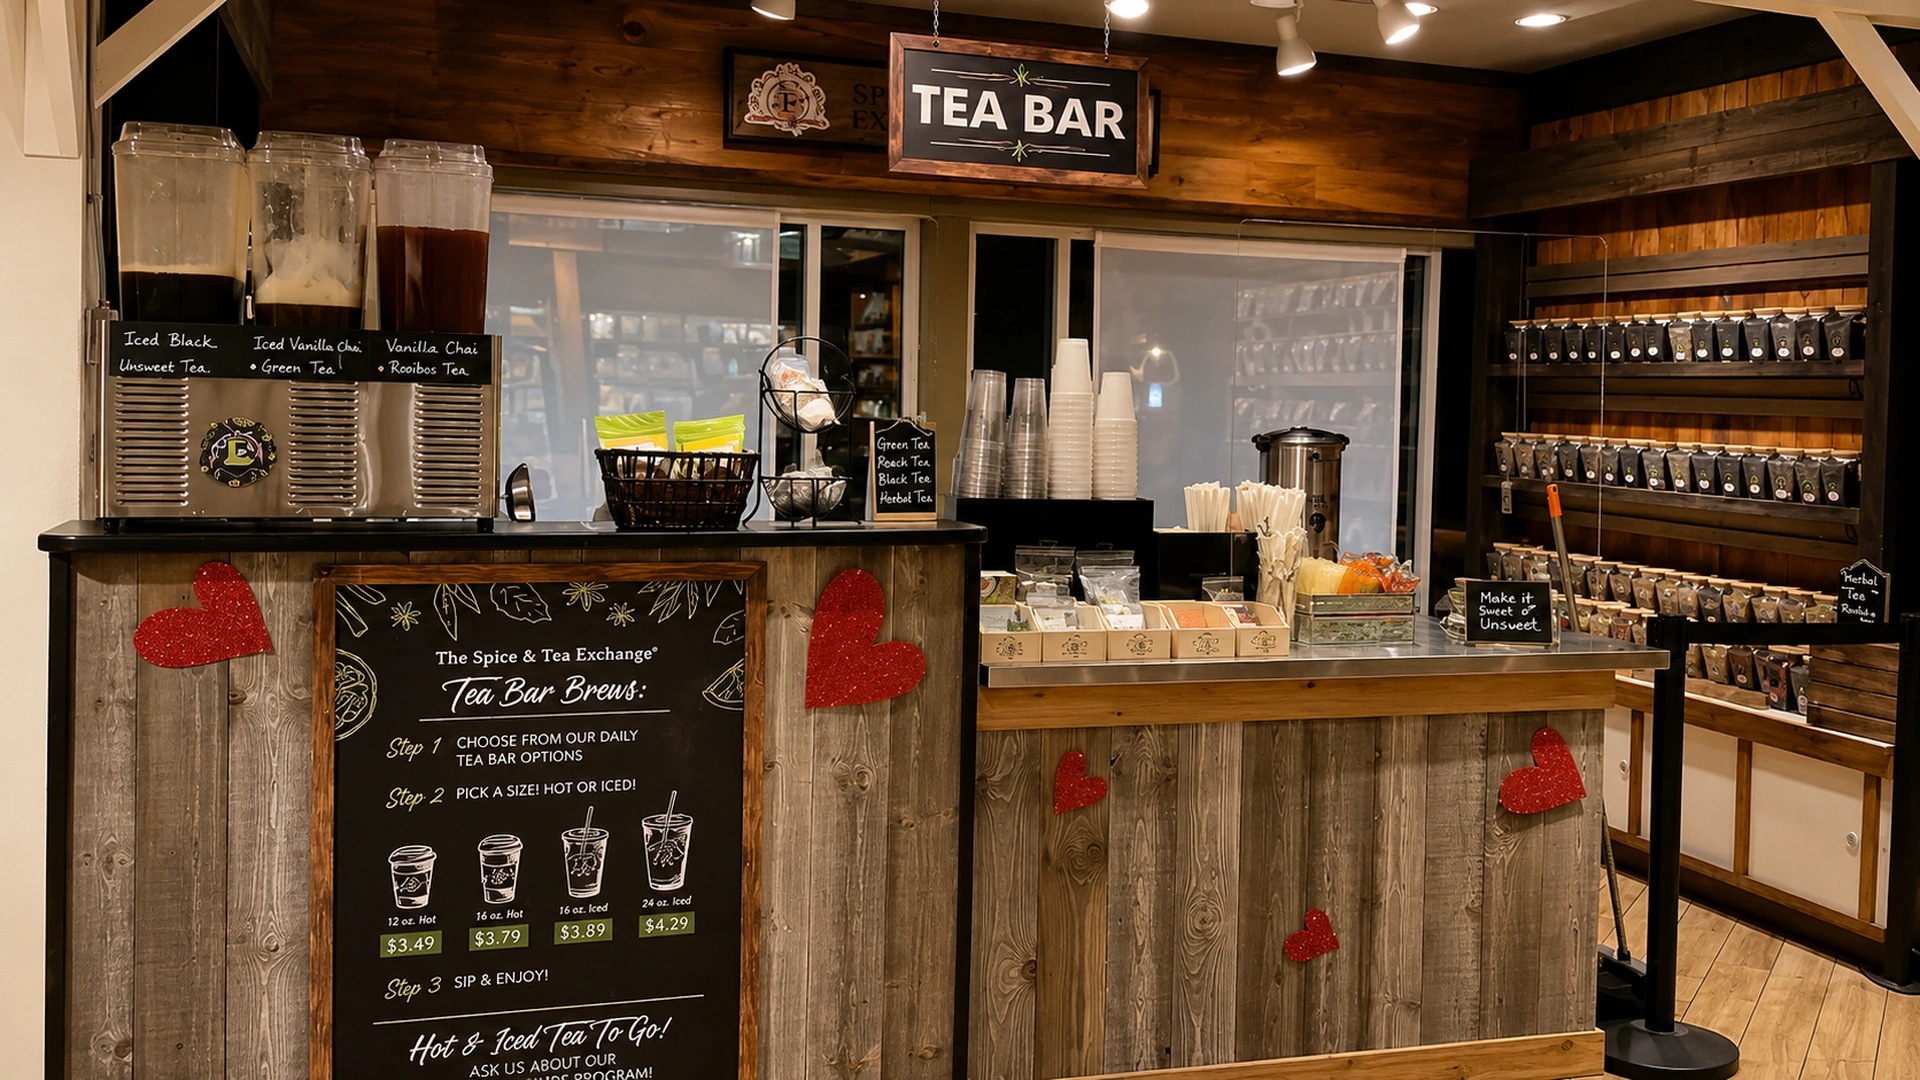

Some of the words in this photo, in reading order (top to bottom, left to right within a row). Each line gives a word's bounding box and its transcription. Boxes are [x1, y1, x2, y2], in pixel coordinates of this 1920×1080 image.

[912, 83, 1008, 131] TEA
[1024, 94, 1126, 140] BAR
[123, 331, 160, 347] Iced
[168, 332, 218, 349] Black
[253, 335, 284, 350] Iced
[289, 336, 334, 351] Vanilla
[385, 338, 439, 354] Vanilla
[445, 341, 478, 355] Chai
[119, 358, 175, 373] Unsweet
[261, 359, 301, 375] Green
[309, 361, 336, 375] Tea
[388, 360, 437, 375] Rooibos
[442, 362, 470, 376] Tea
[876, 437, 909, 452] Green
[910, 437, 930, 450] Tea
[878, 472, 907, 486] Black
[1480, 591, 1516, 603] Make
[1522, 592, 1534, 604] it
[1479, 605, 1513, 616] Sweet
[436, 651, 468, 665] The
[473, 650, 518, 668] Spice
[523, 649, 536, 663] &
[541, 649, 570, 662] Tea
[442, 676, 503, 714] Tea
[499, 677, 556, 707] Bar
[560, 675, 647, 705] Brews:
[386, 737, 424, 762] Step
[432, 737, 442, 754] 1
[457, 735, 517, 749] CHOOSE
[521, 733, 562, 746] FROM
[565, 731, 596, 744] OUR
[600, 729, 639, 743] DAILY
[456, 754, 483, 767] TEA
[488, 752, 516, 765] BAR
[520, 750, 583, 764] OPTIONS
[385, 787, 424, 812] Step
[429, 787, 445, 804] 2
[457, 786, 489, 800] PICK
[492, 784, 503, 798] A
[506, 782, 540, 797] SIZE!
[544, 781, 573, 795] HOT
[576, 780, 597, 793] OR
[601, 779, 636, 792] ICED!
[559, 906, 570, 915] 16
[588, 903, 609, 913] Iced
[642, 899, 654, 909] 24
[672, 895, 692, 906] Iced
[388, 917, 399, 927] 12
[418, 915, 437, 925] Hot
[476, 911, 487, 921] 16
[506, 909, 524, 919] Hot
[560, 922, 606, 941] $3.89
[645, 916, 688, 934] $4.29
[387, 935, 435, 955] $3.49
[474, 929, 521, 948] $3.79
[384, 977, 421, 1003] Step
[428, 976, 442, 994] 3
[454, 975, 476, 989] SIP
[480, 973, 492, 986] &
[496, 969, 549, 985] ENJOY!
[409, 1033, 459, 1066] Hot
[461, 1032, 484, 1057] &
[490, 1025, 543, 1056] Iced
[543, 1020, 596, 1052] Tea
[589, 1016, 638, 1049] To
[628, 1014, 672, 1047] Go!
[469, 1064, 500, 1079] ASK
[504, 1061, 525, 1075] US
[530, 1056, 581, 1073] ABOUT
[585, 1053, 616, 1069] OUR
